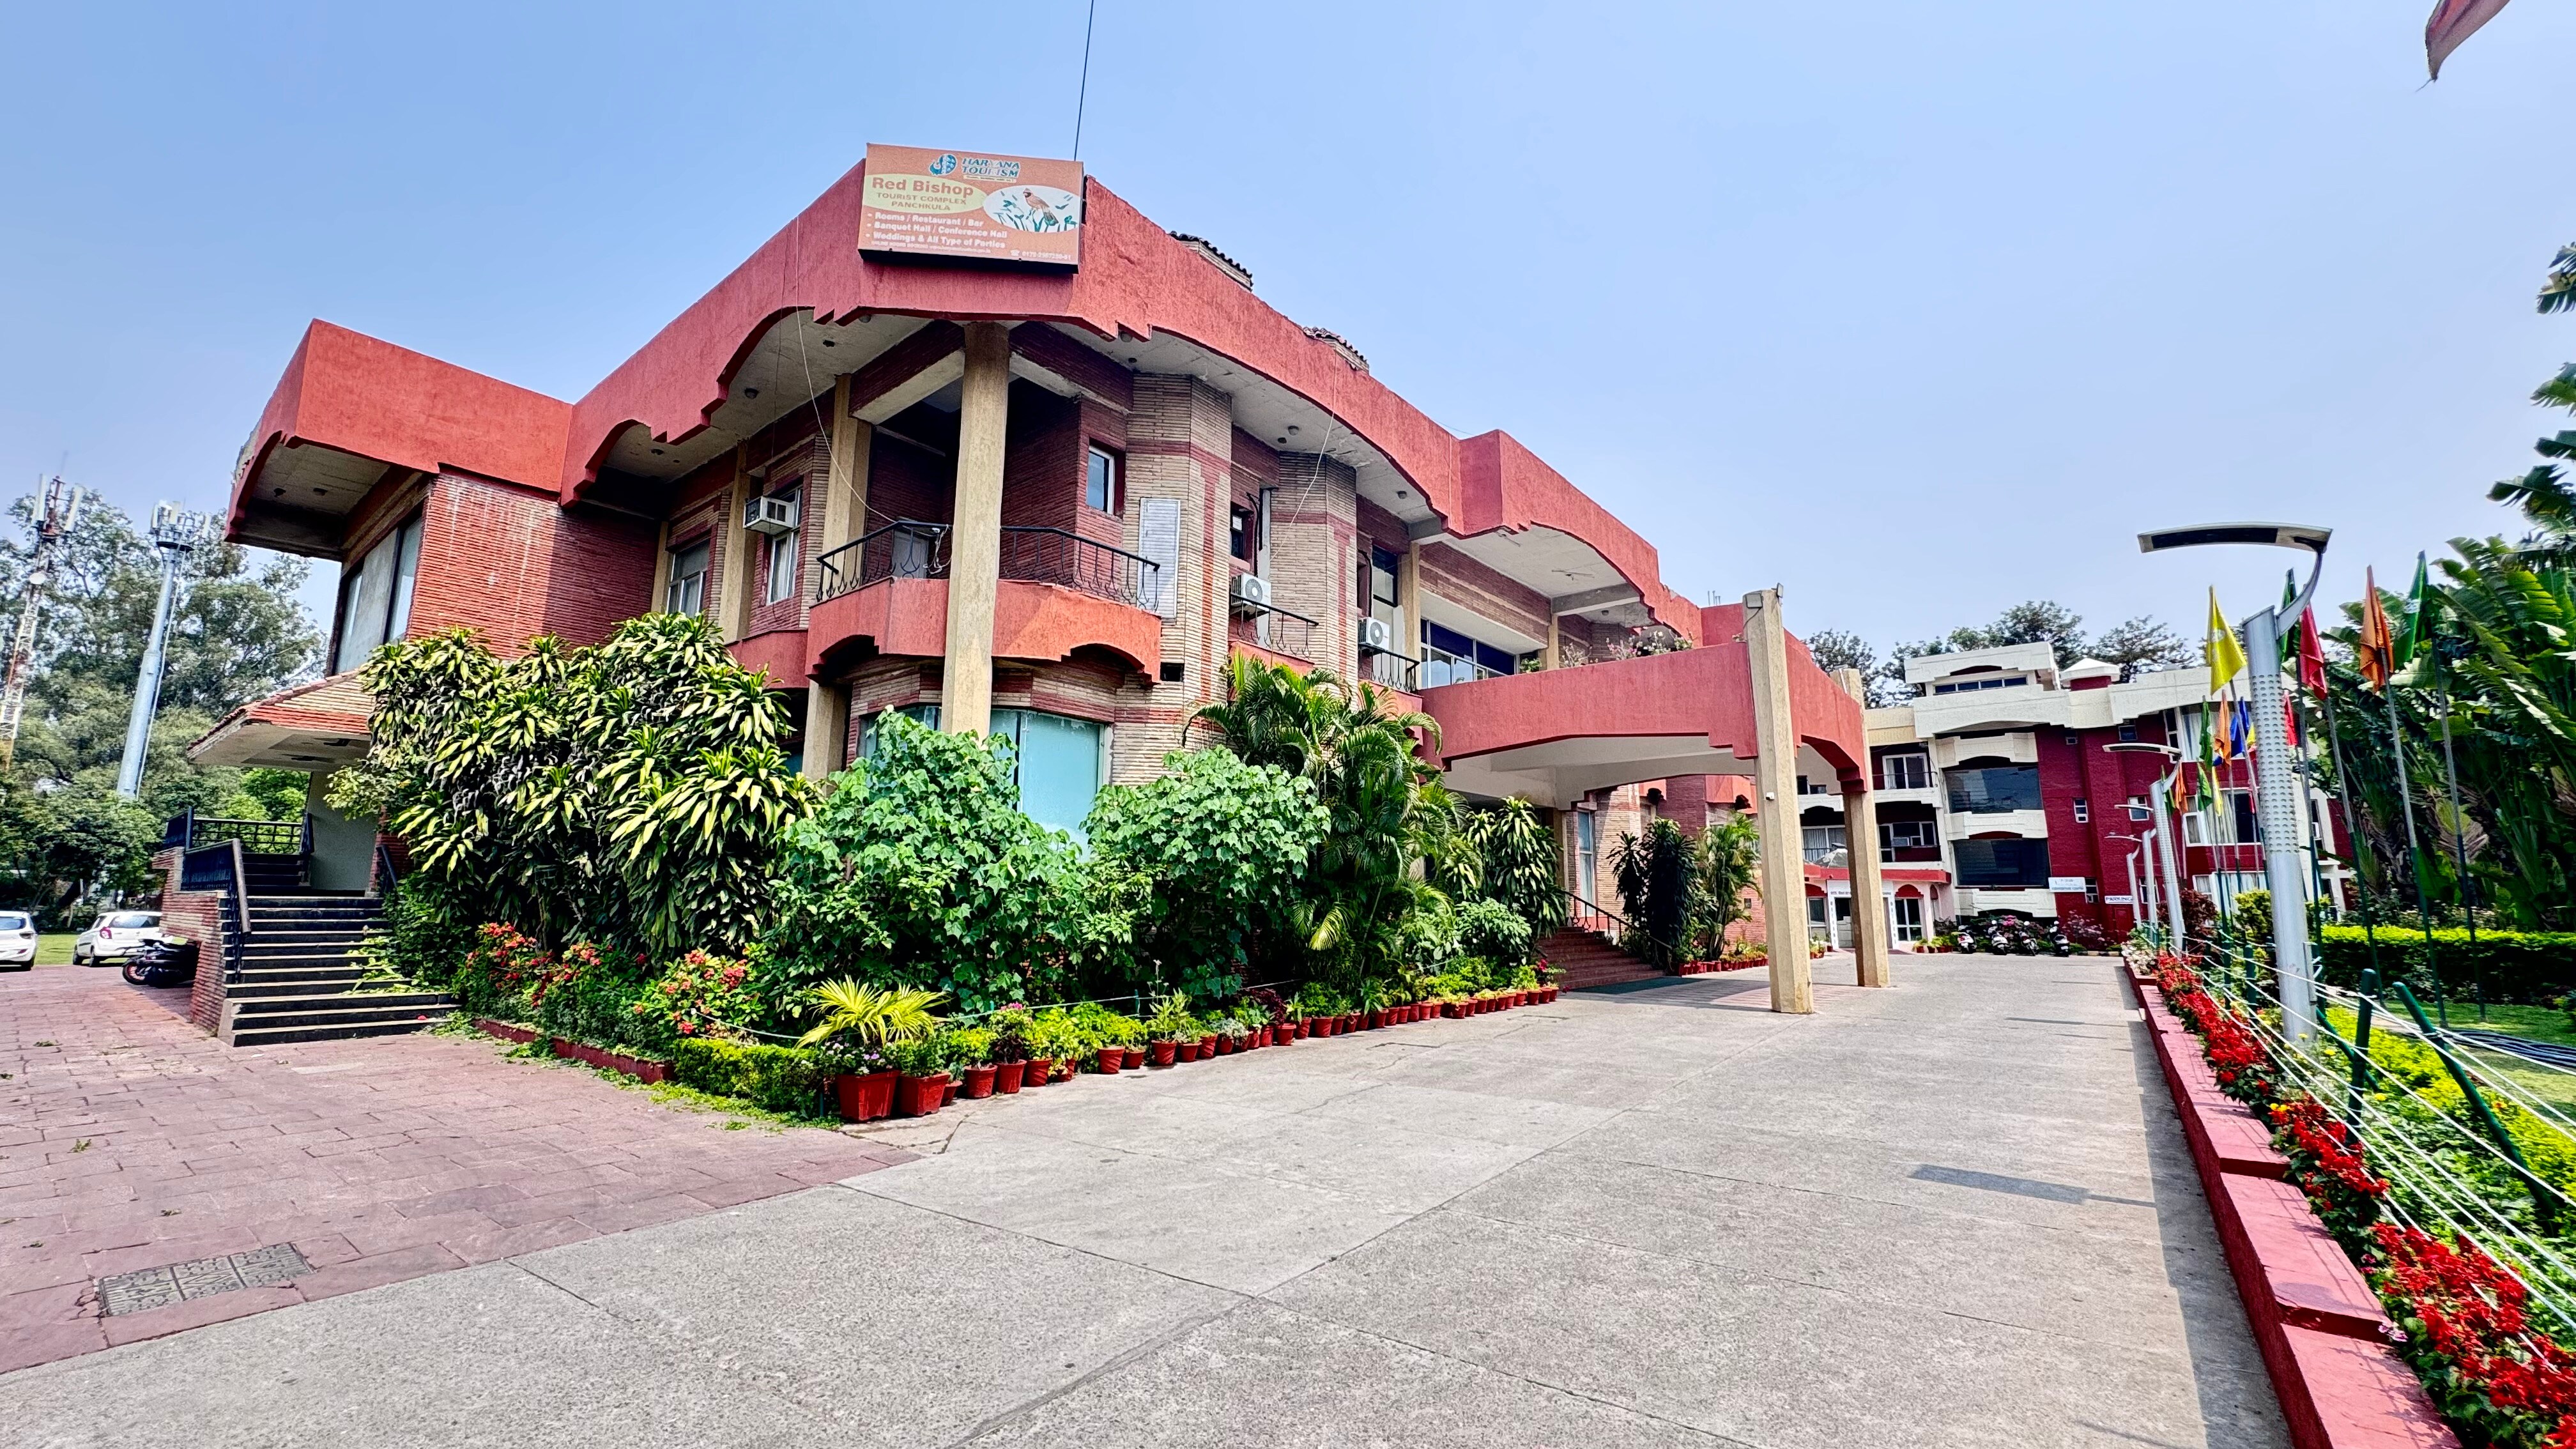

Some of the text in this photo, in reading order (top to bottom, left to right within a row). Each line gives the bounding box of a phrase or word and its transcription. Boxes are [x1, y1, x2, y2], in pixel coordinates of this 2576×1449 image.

[872, 177, 974, 198] Red Bishop
[877, 192, 967, 205] TOURIST COMPLEX
[891, 201, 951, 211] PANCHKULA
[875, 212, 905, 222] Rooms
[912, 215, 961, 226] Restaurant
[968, 218, 984, 227] Bar
[874, 221, 912, 232] Banquet
[913, 224, 931, 232] Hall
[938, 226, 988, 237] Conference
[990, 230, 1008, 238] Hall
[873, 231, 916, 243] Weddings
[927, 234, 939, 243] All
[940, 236, 962, 247] Type
[974, 239, 1006, 249] Parties
